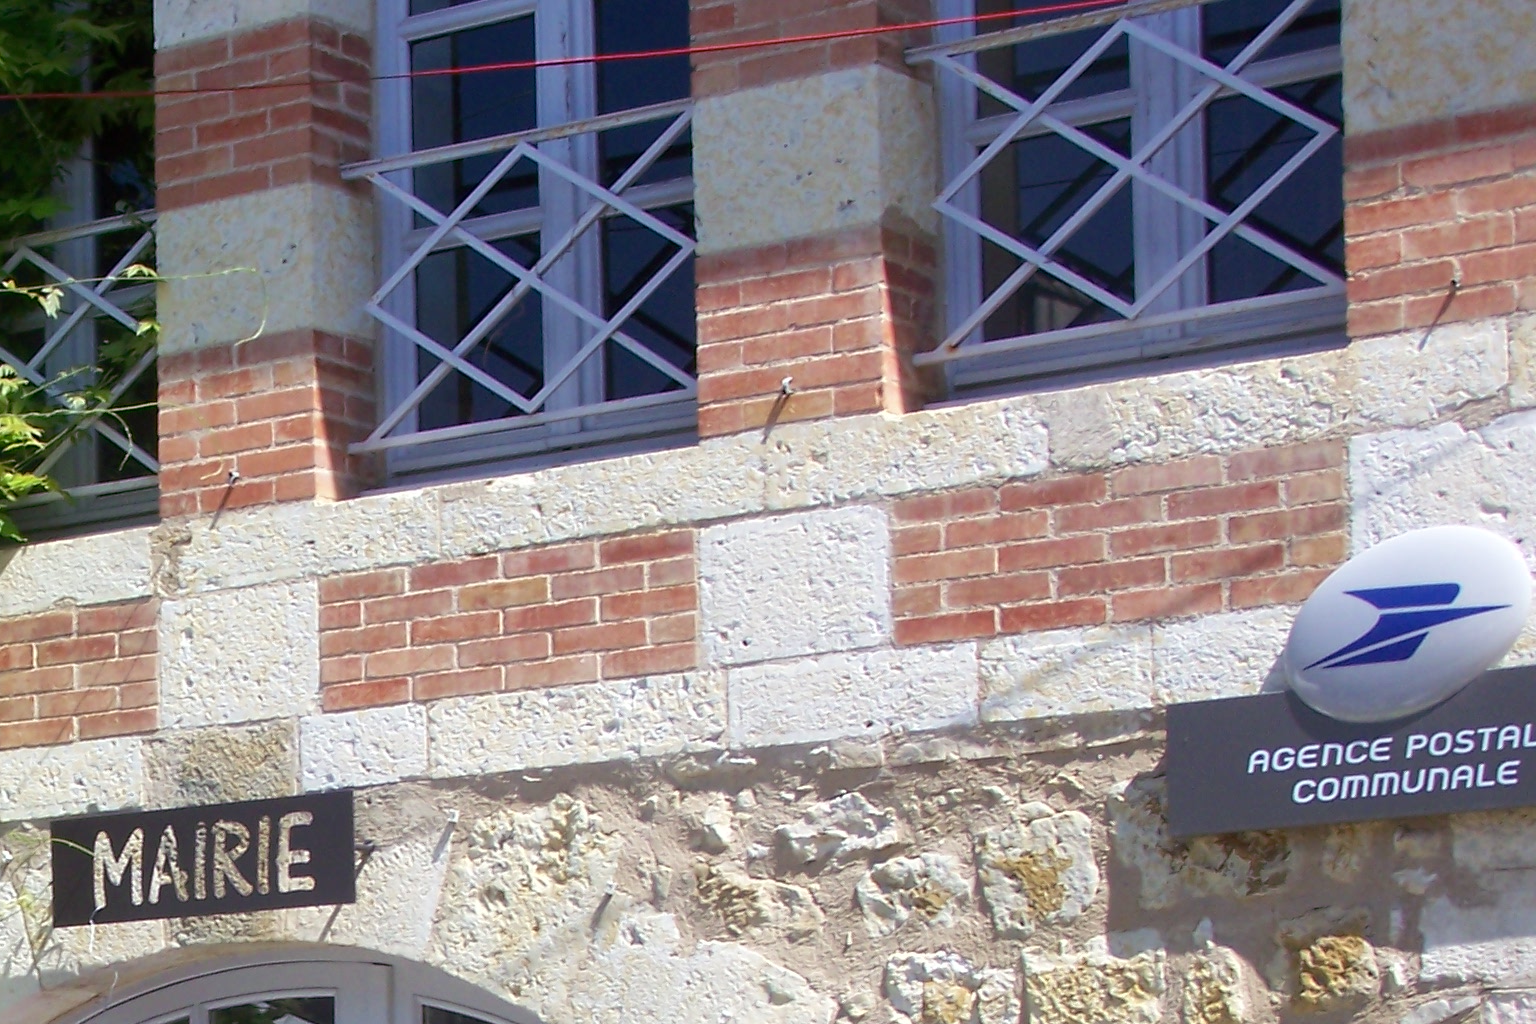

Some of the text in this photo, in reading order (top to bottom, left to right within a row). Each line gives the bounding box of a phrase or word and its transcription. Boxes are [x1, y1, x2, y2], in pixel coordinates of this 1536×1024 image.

[1247, 722, 1536, 774] AGENCE POSTAL
[1292, 759, 1522, 805] COMMUNALE
[92, 810, 315, 908] MAIRIE
